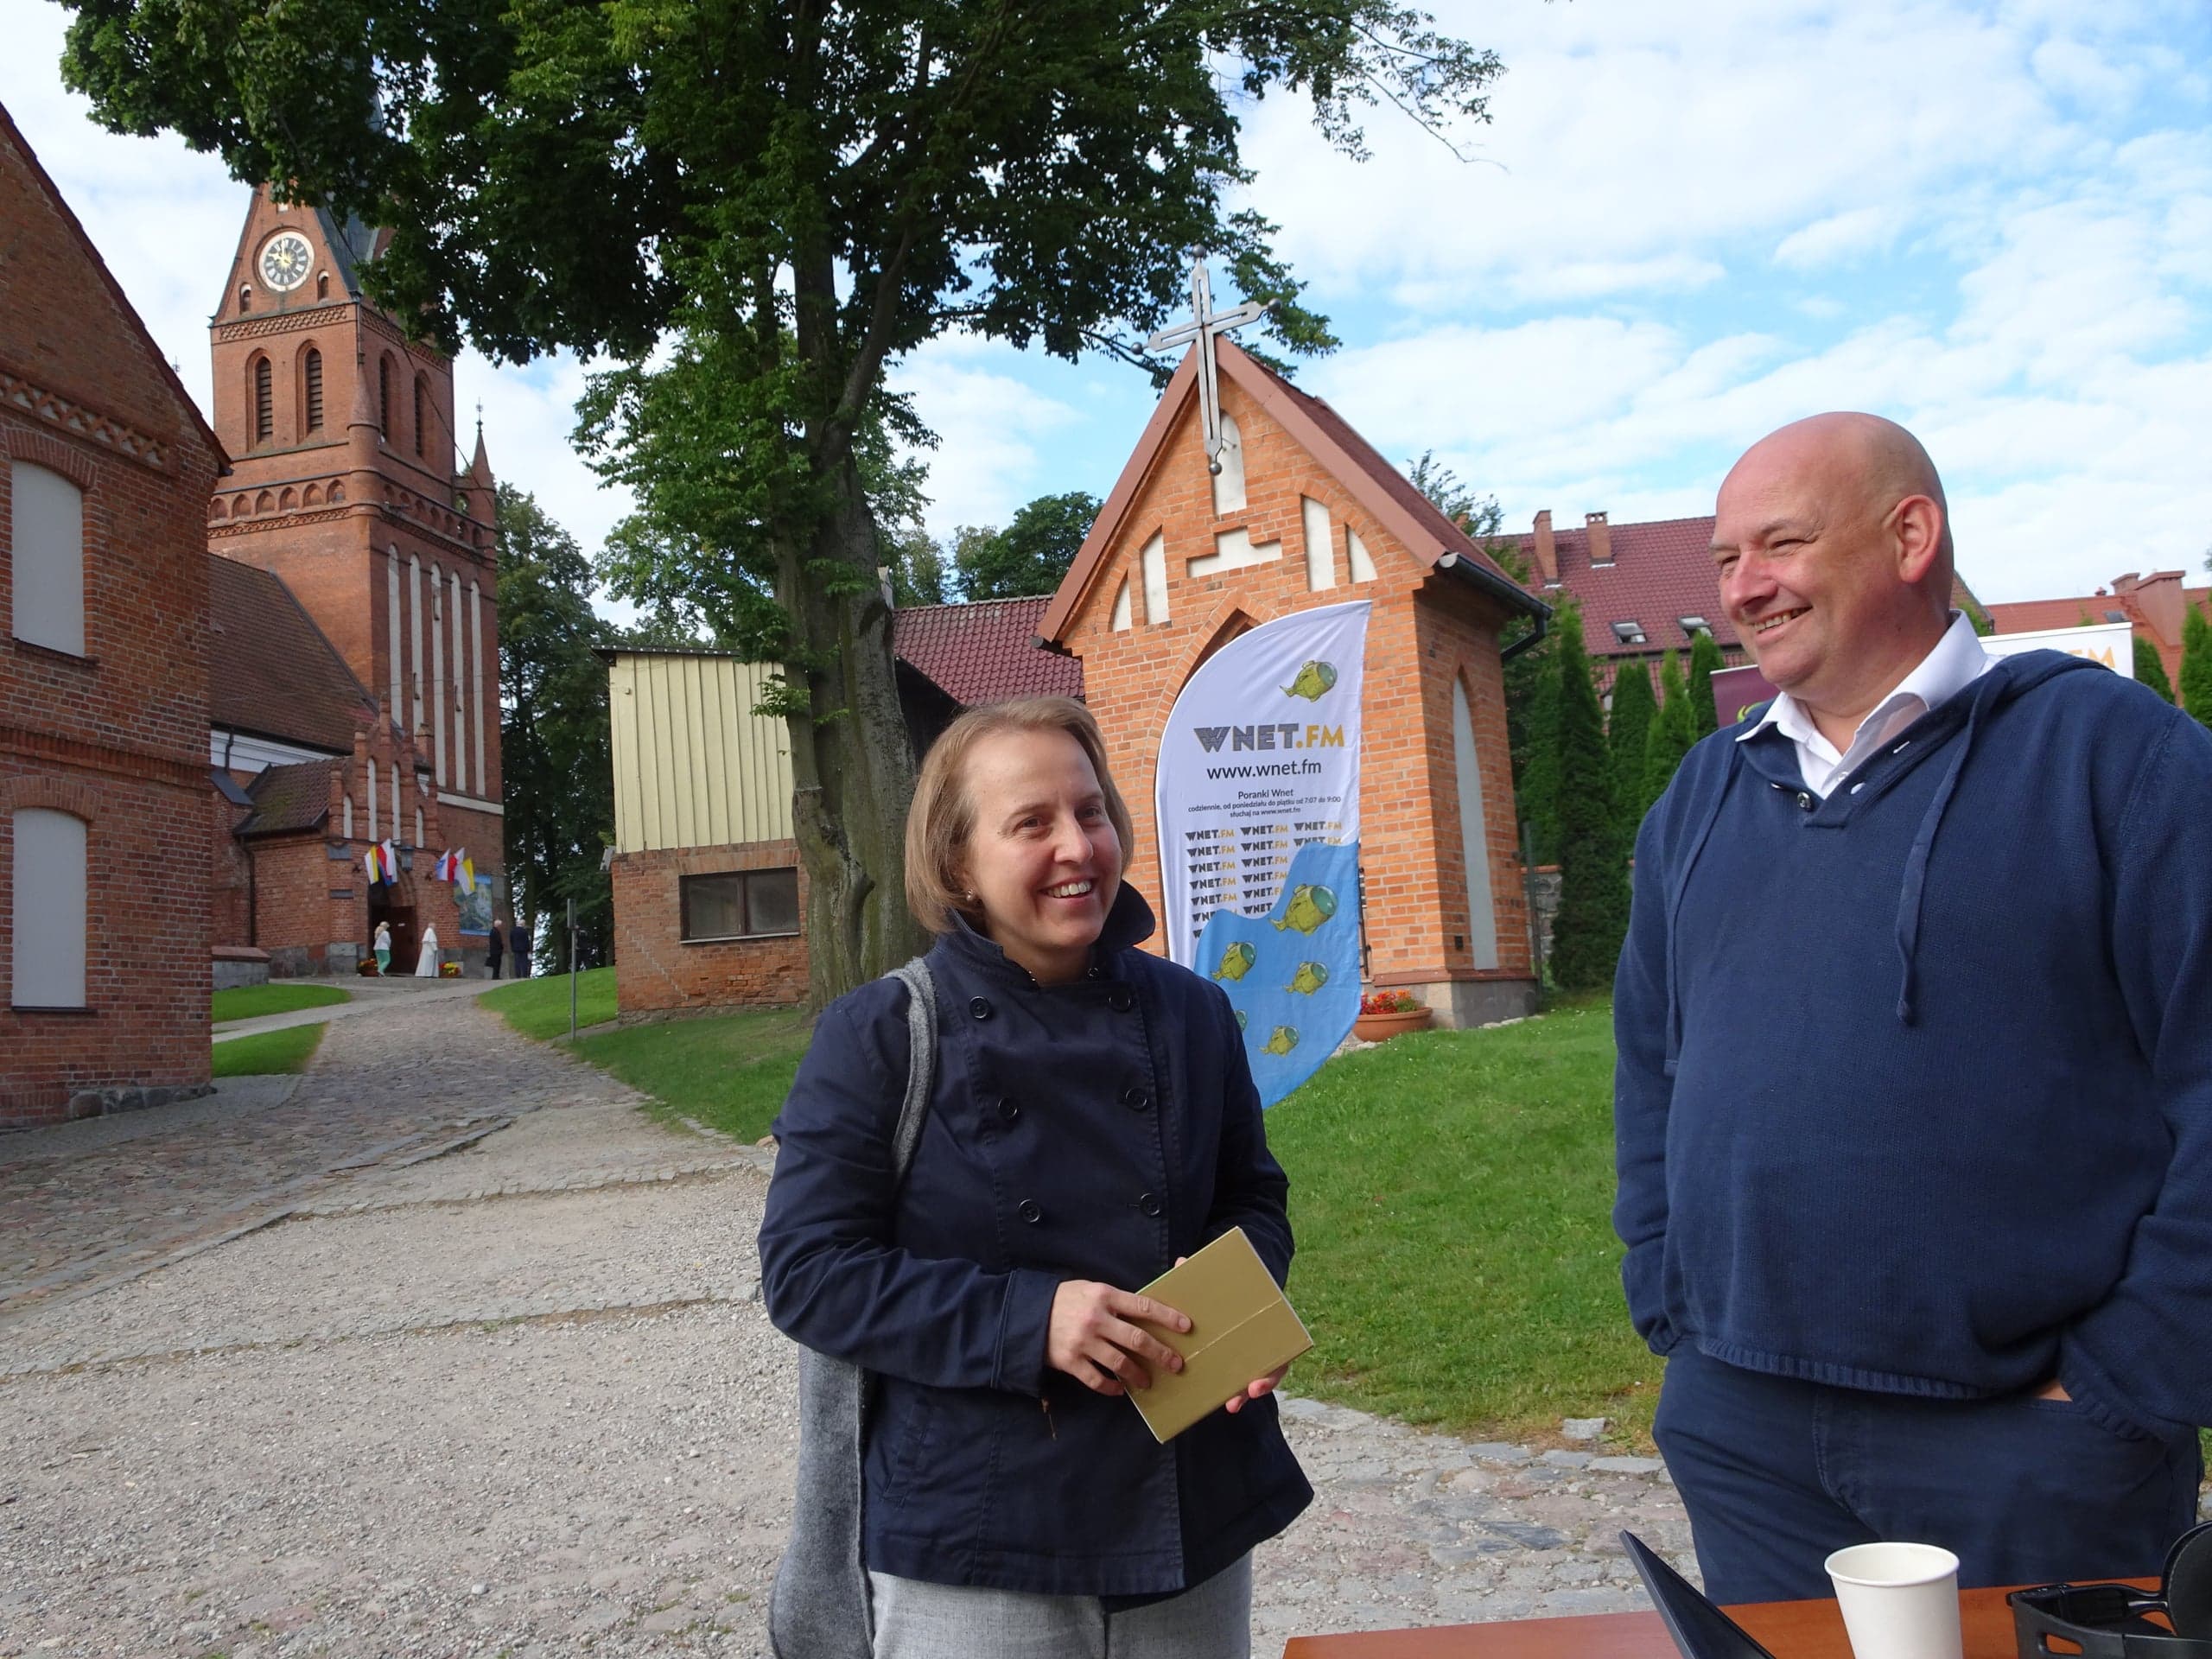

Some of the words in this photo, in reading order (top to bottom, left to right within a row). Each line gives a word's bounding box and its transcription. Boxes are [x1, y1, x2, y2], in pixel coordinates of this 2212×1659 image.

[1193, 723, 1344, 753] WNET.FM
[1207, 759, 1321, 779] www.wnet.fm
[1238, 790, 1269, 799] Poranki
[1188, 804, 1222, 812] codziennie,
[1261, 807, 1301, 816] www.wnet.fm
[1185, 830, 1235, 842] WNET.FM
[1240, 824, 1288, 836] WNET.FM
[1294, 821, 1342, 831] WNET.FM
[1186, 845, 1236, 857] WNET.FM
[1241, 840, 1288, 852] WNET.FM
[1188, 861, 1236, 874] WNET.FM
[1241, 855, 1287, 868] WNET.FM
[1190, 878, 1236, 890] WNET.FM
[1242, 871, 1287, 883] WNET.FM
[1191, 893, 1237, 906] WNET.FM
[1243, 887, 1282, 899] WNET.F
